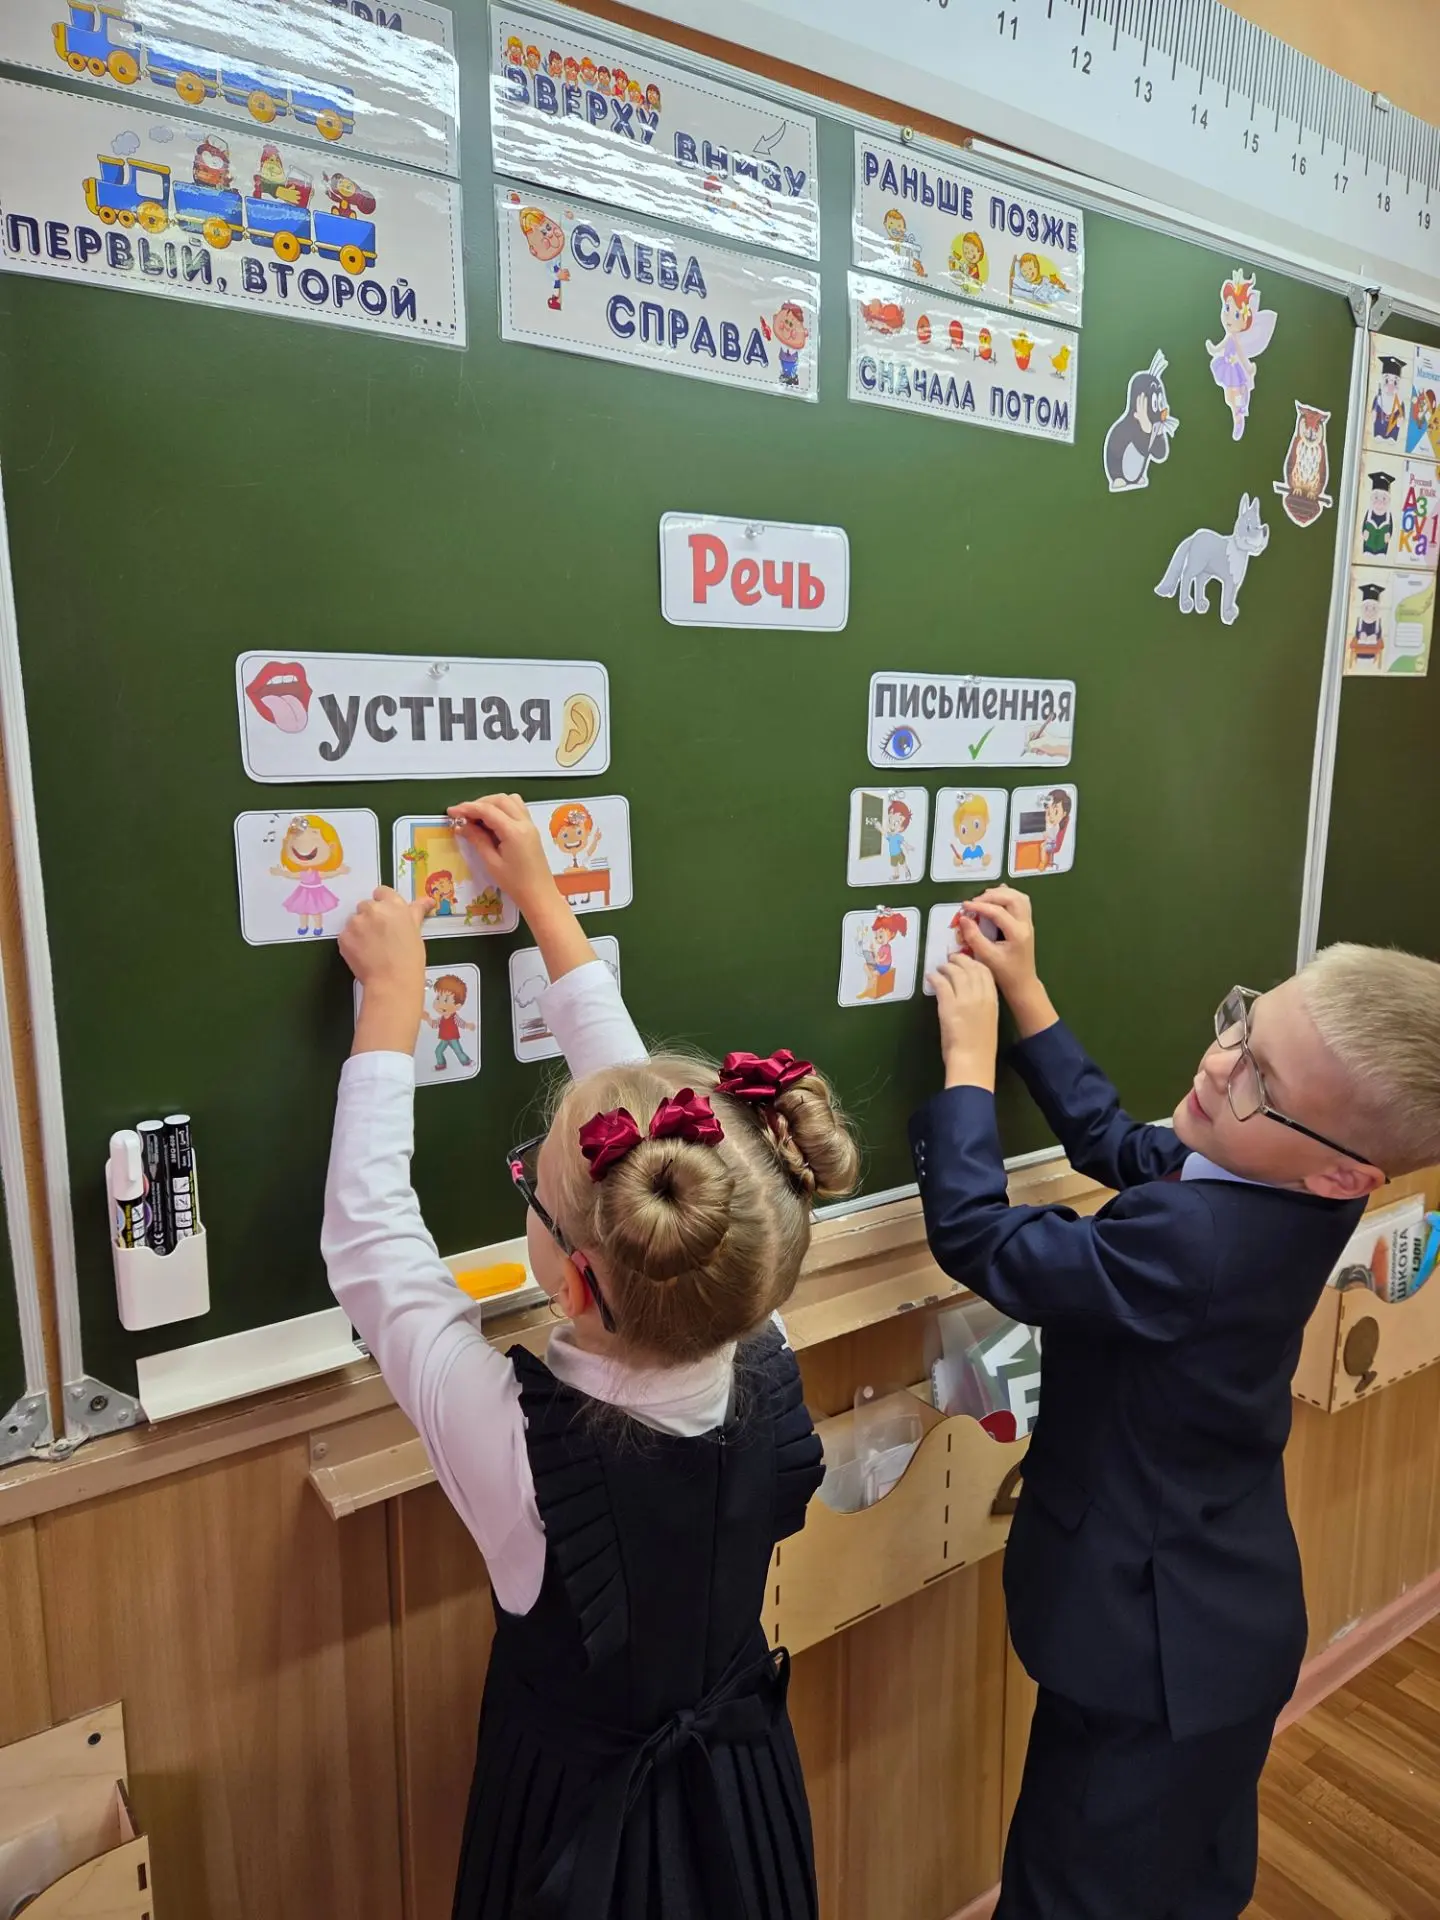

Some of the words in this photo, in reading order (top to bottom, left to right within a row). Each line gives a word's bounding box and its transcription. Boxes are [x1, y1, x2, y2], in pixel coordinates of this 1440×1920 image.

[504, 65, 660, 145] ВВЕРХУ
[674, 131, 807, 198] ВНИЗУ
[997, 10, 1018, 41] 11
[1071, 45, 1092, 75] 12
[1134, 76, 1153, 103] 13
[1191, 104, 1208, 129] 14
[1243, 129, 1259, 153] 15
[1291, 153, 1306, 176] 16
[1334, 173, 1349, 194] 17
[1377, 192, 1391, 213] 18
[1418, 210, 1431, 230] 19
[863, 150, 974, 221] РАНЬШЕ
[989, 196, 1079, 253] ПОЗЖЕ
[6, 213, 228, 293] ПЕРВЫЙ,
[570, 224, 707, 299] СЛЕВА
[605, 294, 770, 368] СПРАВА
[857, 355, 976, 412] СНАЧАЛА
[989, 386, 1069, 431] ПОТОМ
[688, 533, 826, 610] Речь
[317, 692, 552, 762] устная
[874, 683, 1072, 722] письменная
